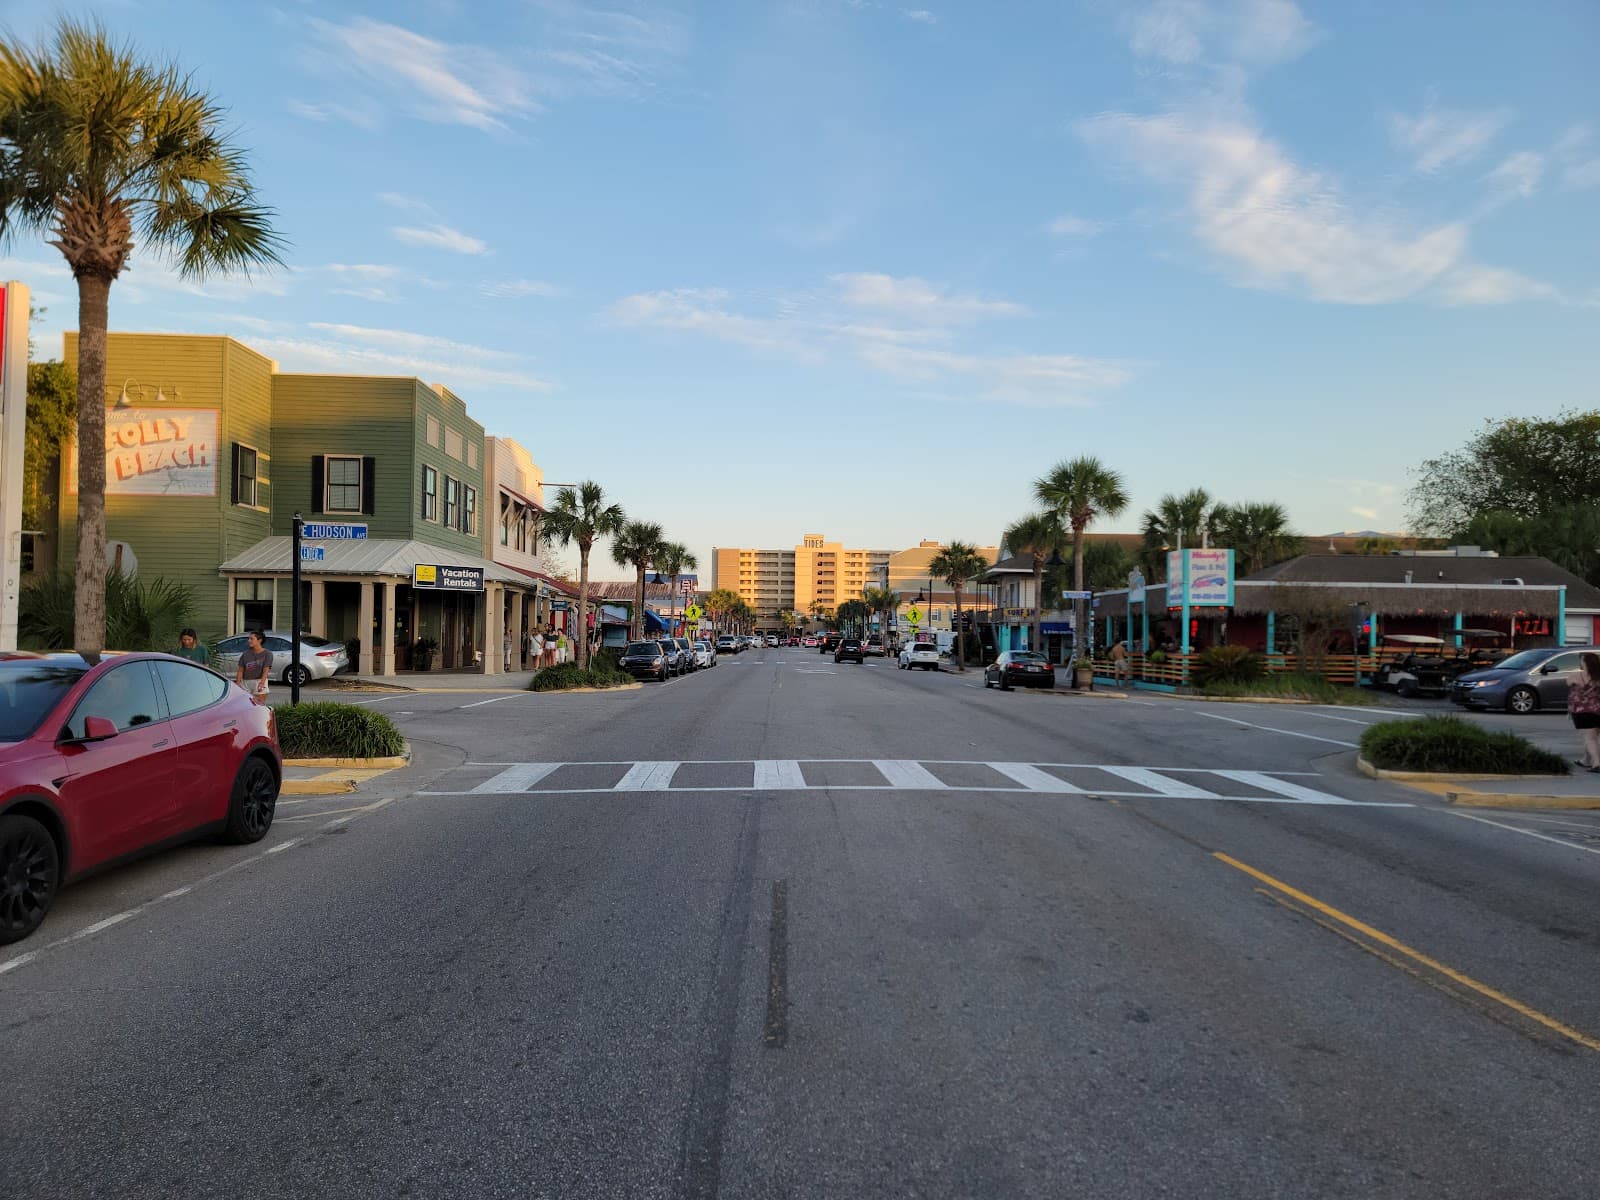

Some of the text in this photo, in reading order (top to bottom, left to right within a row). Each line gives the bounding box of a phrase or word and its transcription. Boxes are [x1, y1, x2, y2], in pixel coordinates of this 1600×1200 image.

[105, 415, 194, 453] FOLLY
[114, 442, 210, 481] BEACH
[303, 525, 367, 540] E HUDSON AVE
[804, 539, 823, 548] TIDES
[441, 568, 480, 579] Vacation
[443, 578, 477, 587] Rentals
